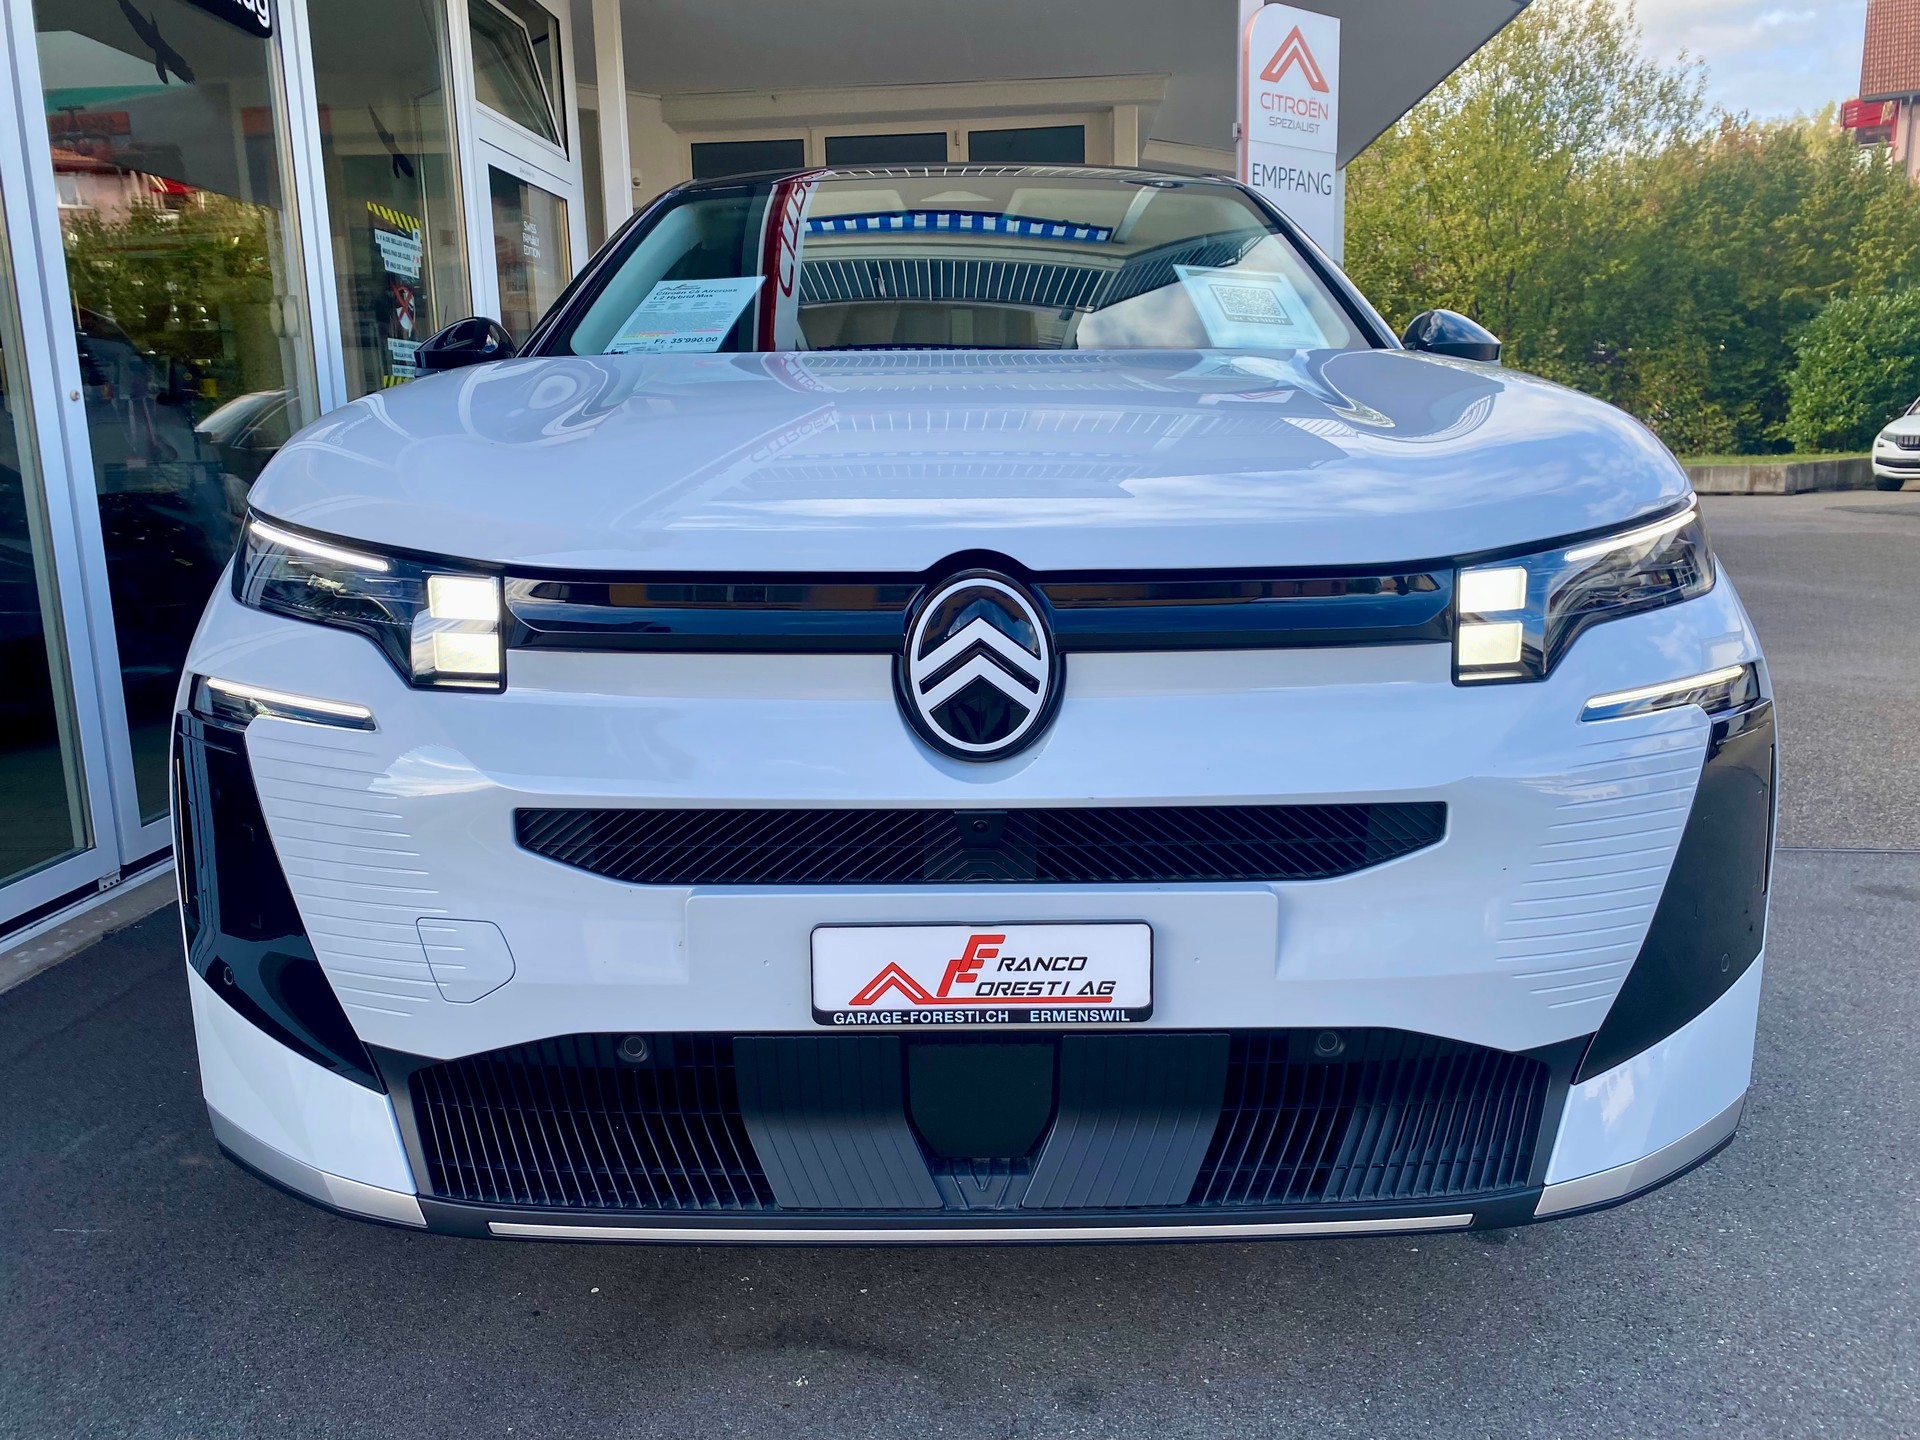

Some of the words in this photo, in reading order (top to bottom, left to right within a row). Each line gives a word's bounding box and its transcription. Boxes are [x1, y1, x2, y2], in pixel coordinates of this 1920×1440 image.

[1261, 92, 1328, 120] CITROËN
[1269, 116, 1320, 134] SPEZIALIST
[1252, 163, 1332, 195] EMPFANG
[523, 245, 541, 259] EDITION
[670, 336, 718, 344] 35'990.00
[1076, 980, 1117, 996] AG
[833, 1011, 1010, 1025] GARAGE-FORESTI.CH
[1030, 1009, 1131, 1023] ERMENSWIL
